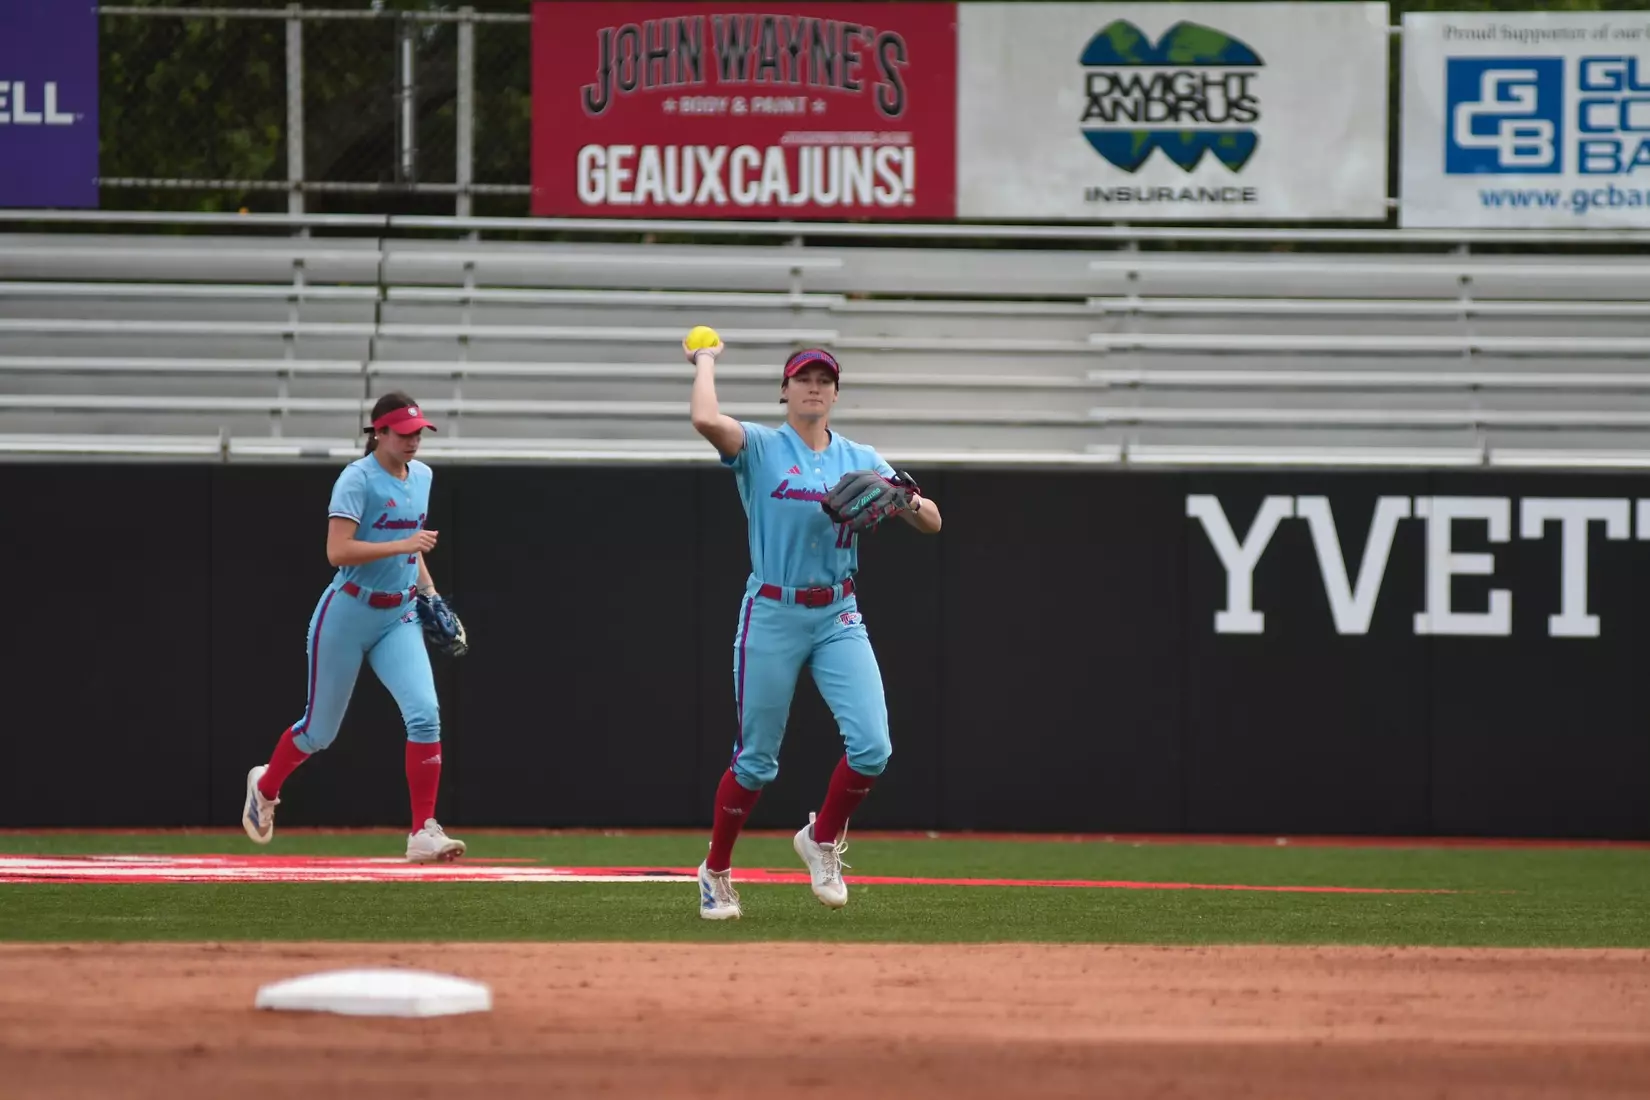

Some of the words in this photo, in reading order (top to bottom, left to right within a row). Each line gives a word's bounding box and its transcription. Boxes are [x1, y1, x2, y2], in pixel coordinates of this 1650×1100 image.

[1442, 24, 1497, 41] Proud
[1592, 23, 1611, 40] of
[581, 16, 705, 117] JOHN
[710, 13, 908, 118] WAYNE'S
[1085, 71, 1258, 98] DWIGHT
[679, 96, 729, 115] BODY
[731, 96, 749, 115] &
[751, 96, 808, 115] PAINT
[1081, 97, 1260, 123] ANDRUS
[1086, 187, 1257, 203] INSURANCE
[1480, 184, 1650, 214] www.gcba
[1186, 494, 1650, 637] YVET
